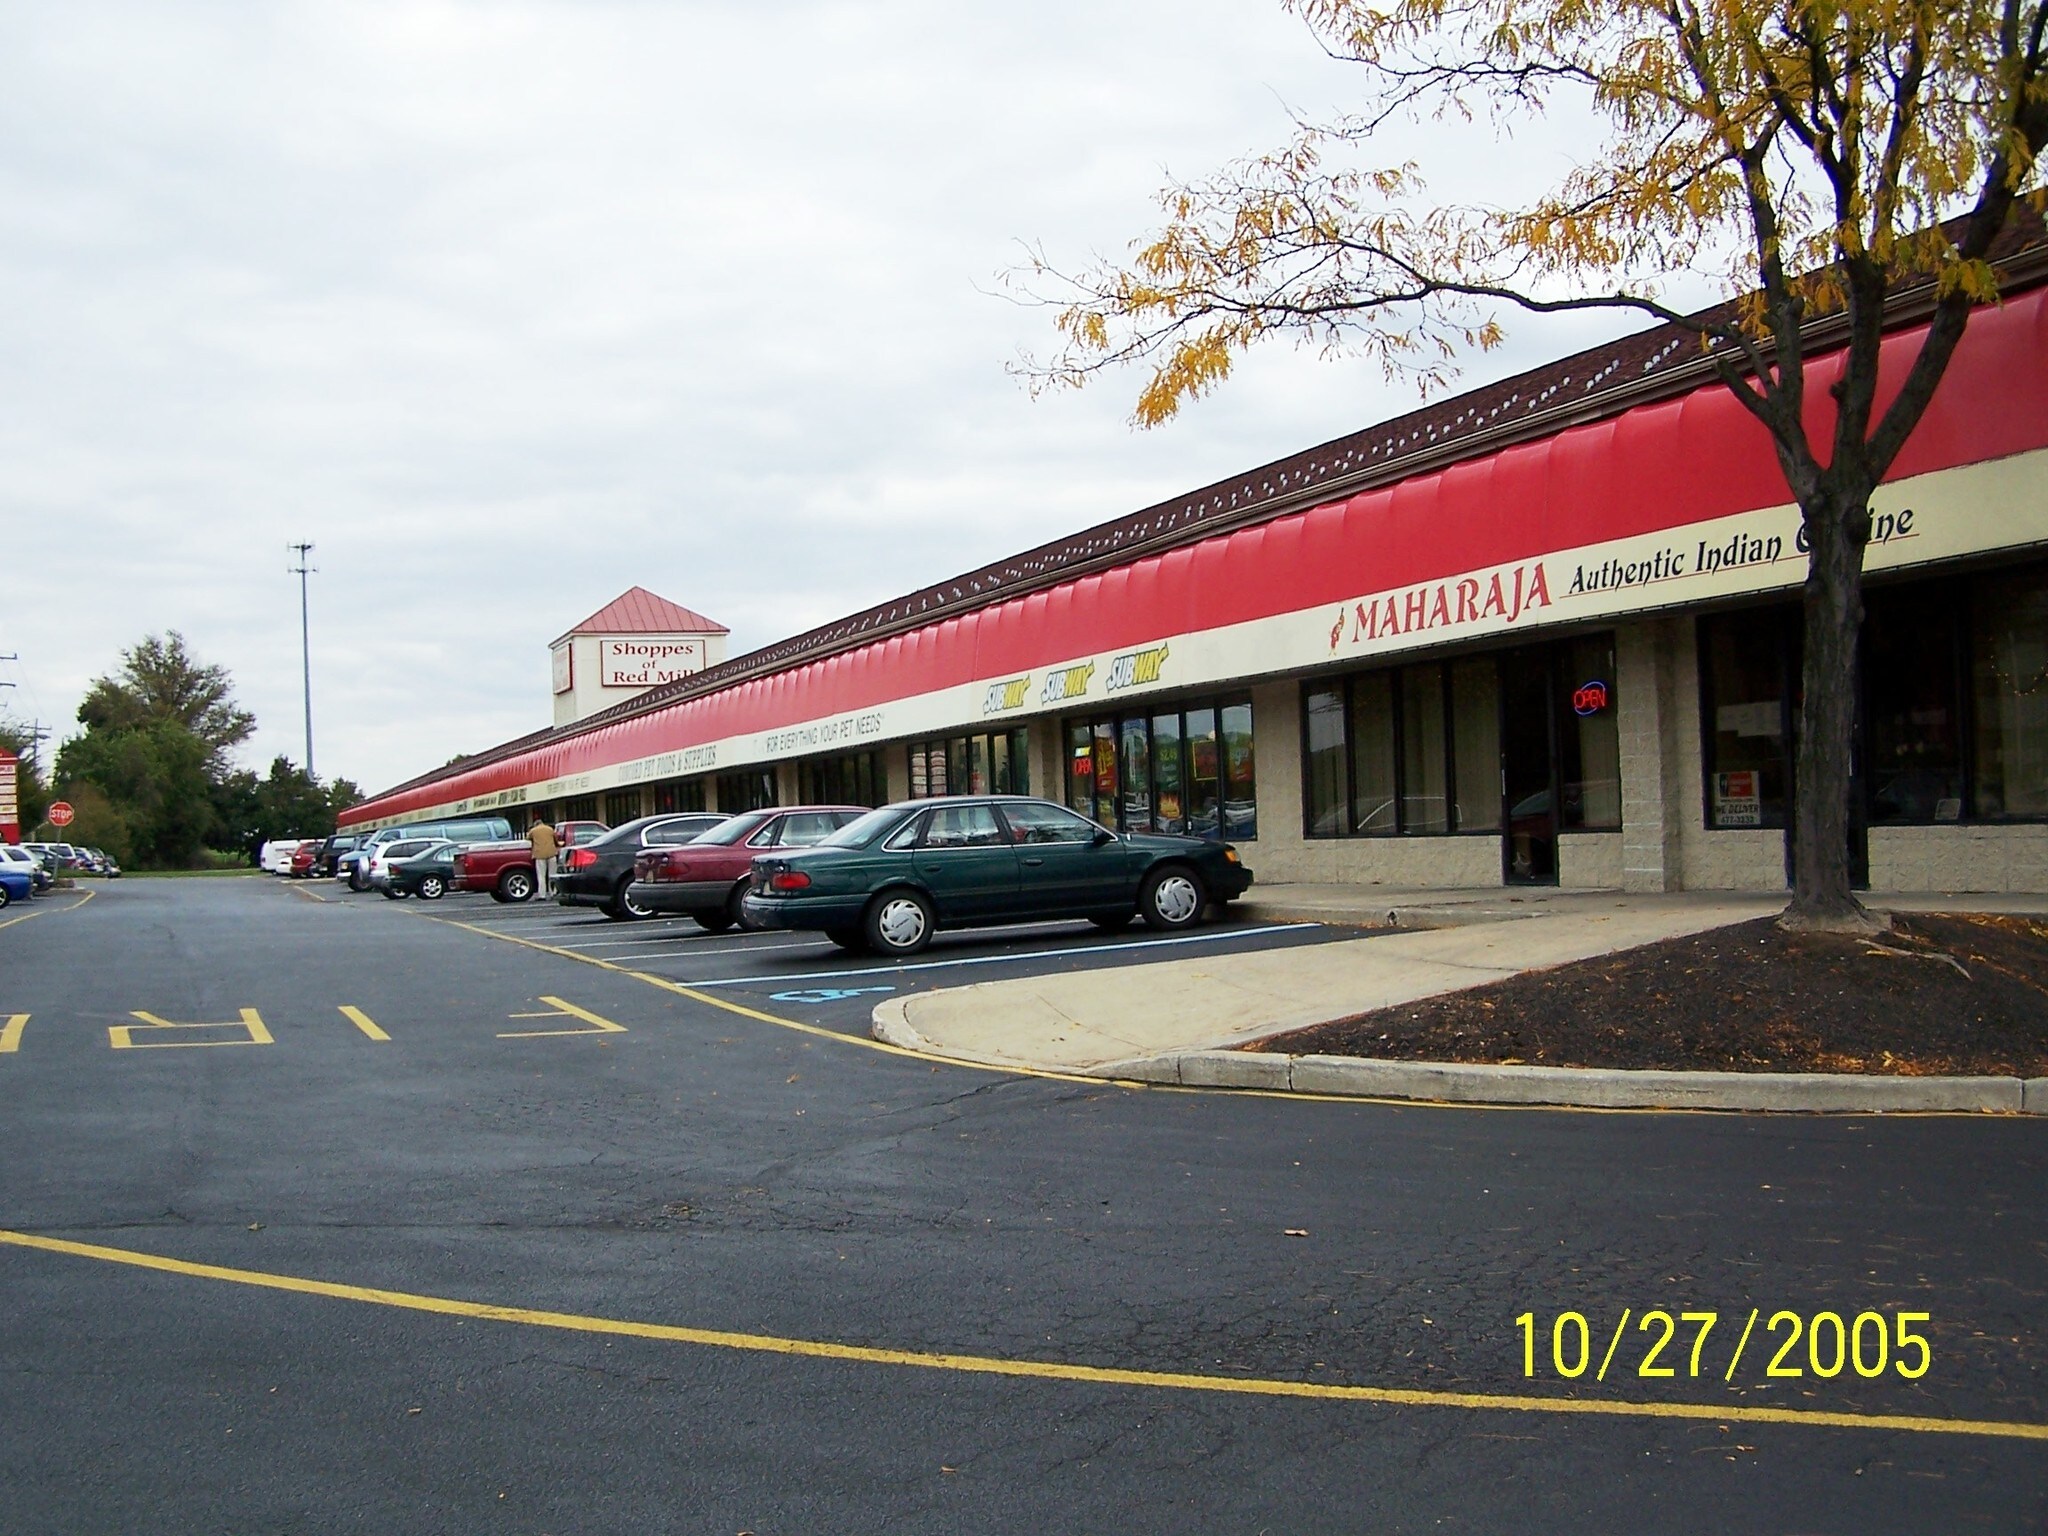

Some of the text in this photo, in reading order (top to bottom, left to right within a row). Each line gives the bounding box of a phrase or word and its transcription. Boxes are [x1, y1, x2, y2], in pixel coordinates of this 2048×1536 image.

[1352, 562, 1552, 643] MAHARAJA
[1569, 548, 1685, 594] Authentic
[1695, 533, 1782, 576] Indian
[612, 643, 694, 658] Shoppes
[614, 670, 648, 682] Red
[642, 660, 658, 669] of
[1105, 642, 1169, 694] SUBWAY
[983, 673, 1031, 716] SUBWAY
[1040, 659, 1095, 706] SUBWAY
[1574, 689, 1605, 708] OPEN
[766, 735, 779, 752] FOR
[780, 727, 818, 751] EVERYTHING
[820, 723, 838, 742] YOUR
[839, 719, 854, 738] PET
[51, 809, 73, 819] STOP
